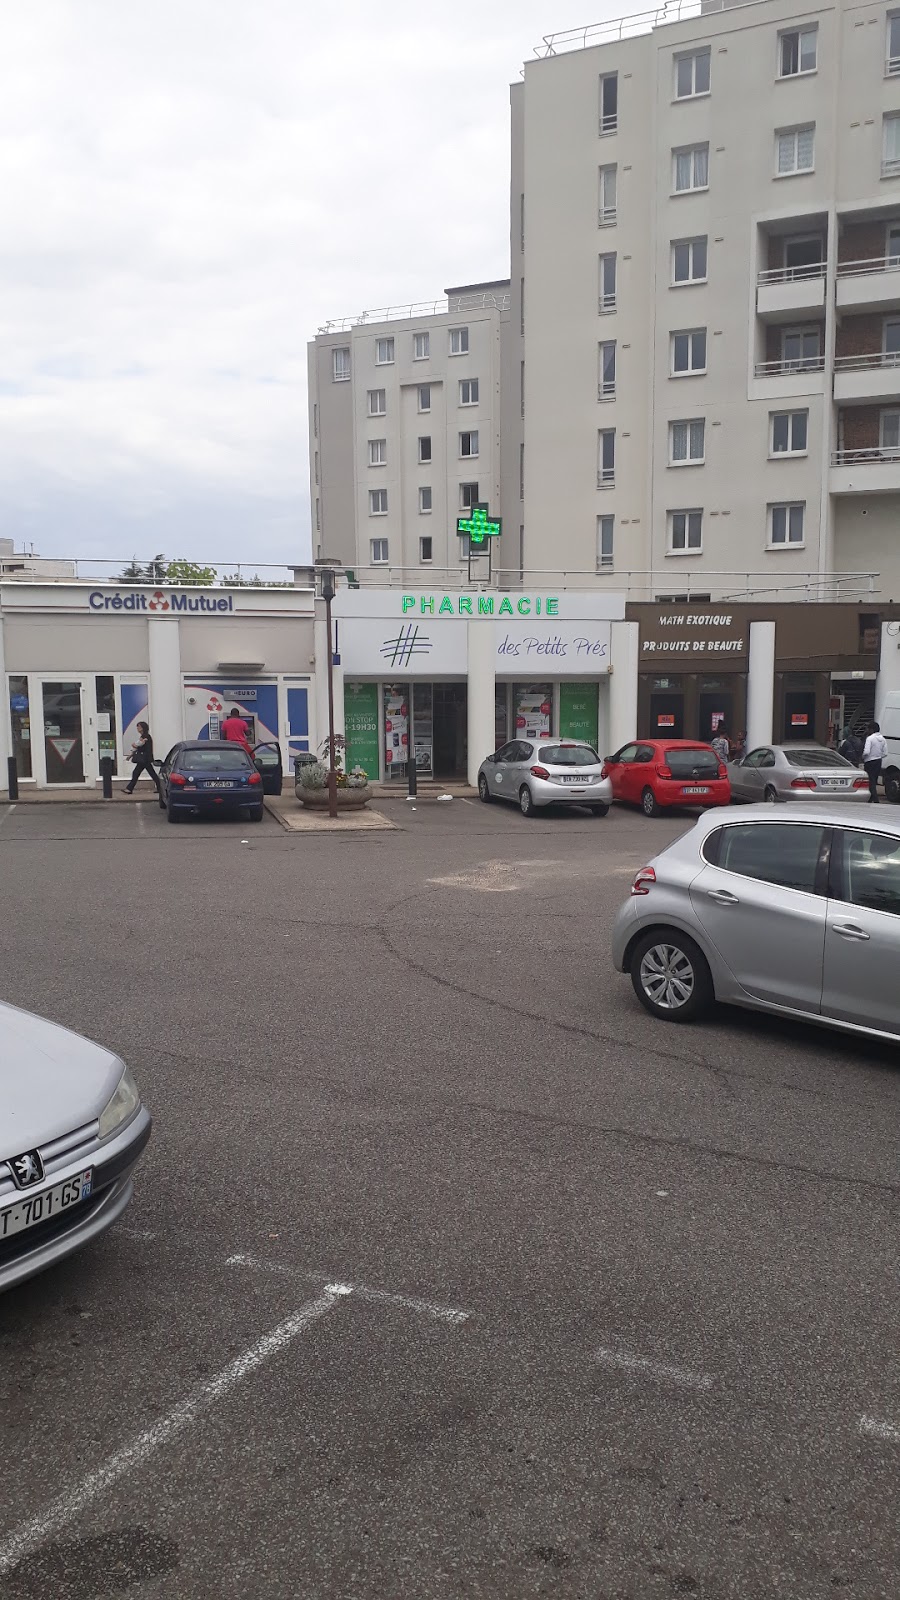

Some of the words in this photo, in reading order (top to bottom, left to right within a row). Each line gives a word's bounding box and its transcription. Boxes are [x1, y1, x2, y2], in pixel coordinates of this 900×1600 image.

[89, 592, 147, 610] Crédit
[171, 594, 233, 612] Mutuel
[402, 595, 559, 615] PHARMACIE
[686, 615, 732, 626] EXOTIQUE
[497, 634, 521, 656] des
[523, 636, 568, 657] Petits
[573, 637, 608, 657] Prés
[692, 641, 705, 651] DE
[707, 638, 744, 651] BEAUTÉ
[0, 1177, 81, 1235] T-701-GS
